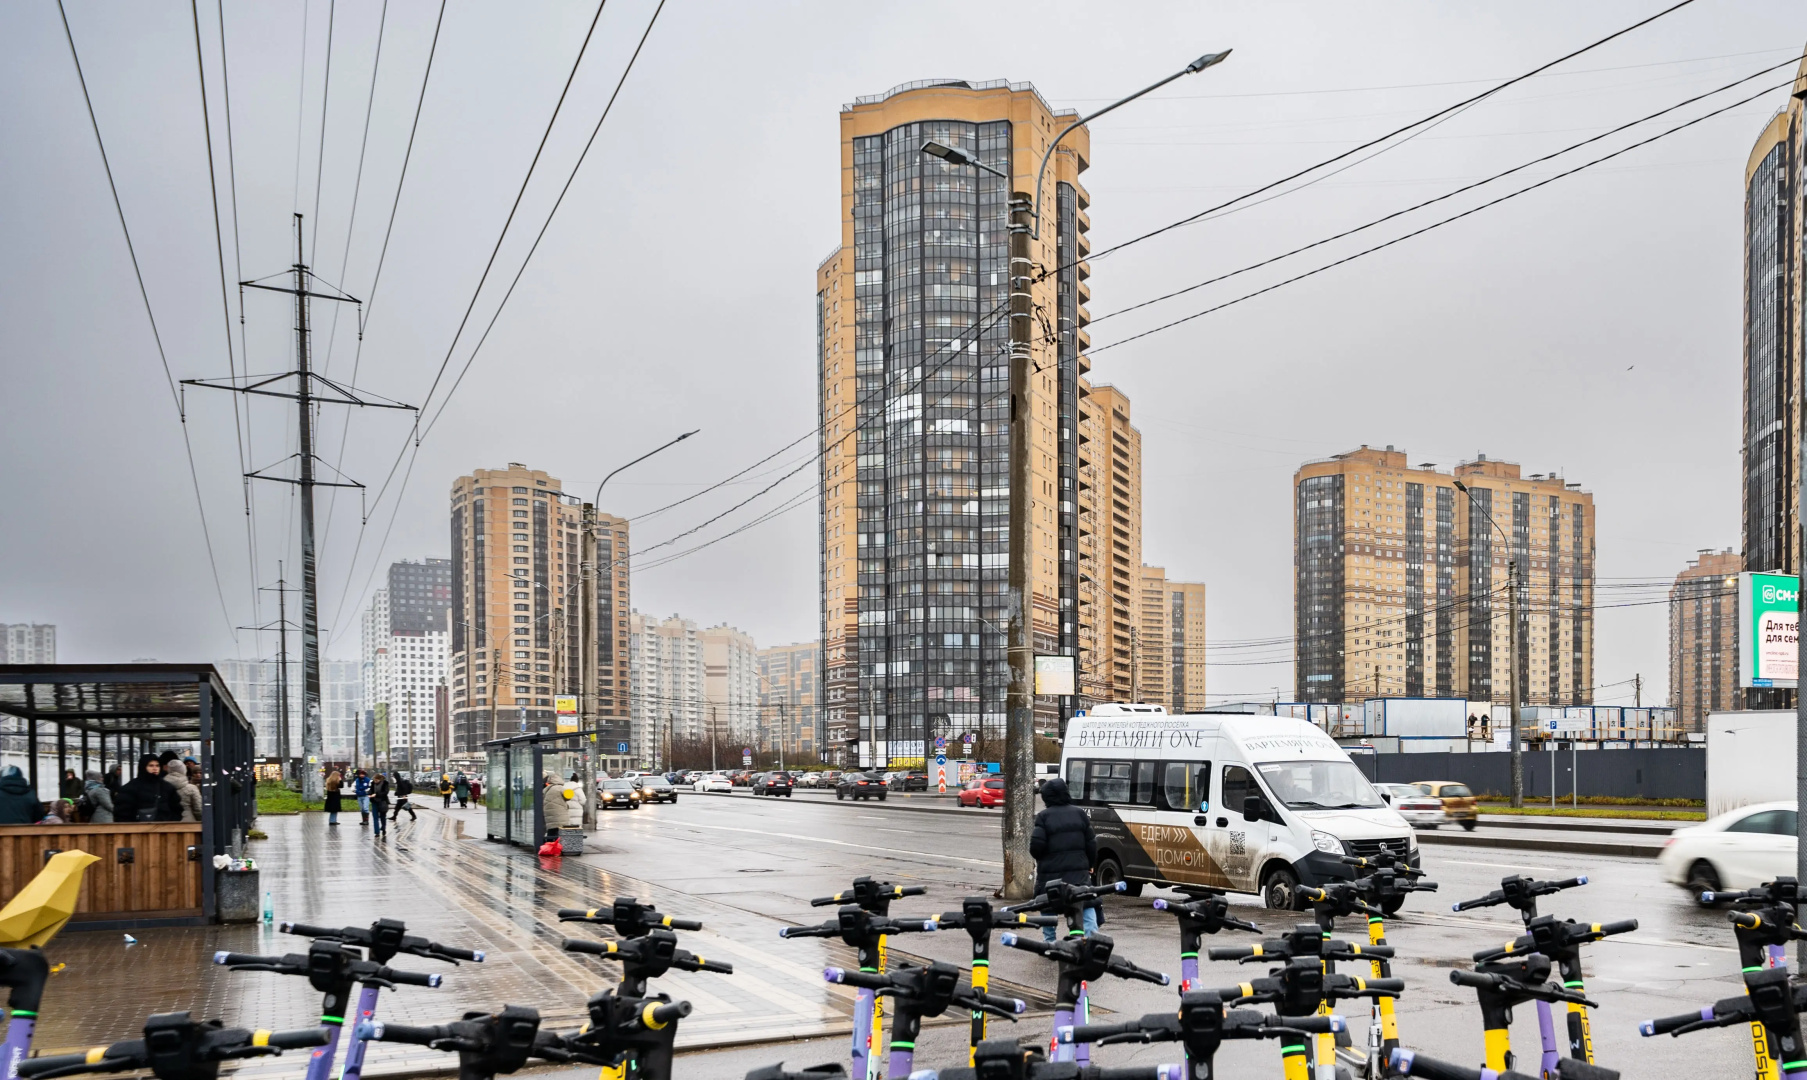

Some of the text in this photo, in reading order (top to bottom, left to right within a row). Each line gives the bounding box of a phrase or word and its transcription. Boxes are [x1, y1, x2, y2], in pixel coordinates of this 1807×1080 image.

[1766, 619, 1784, 632] Для
[1766, 634, 1782, 644] для
[1079, 729, 1204, 748] ВАРТЕМЯГИ ONE
[1141, 825, 1171, 843] ЕДЕМ
[1156, 848, 1204, 867] ДОМОЙ!
